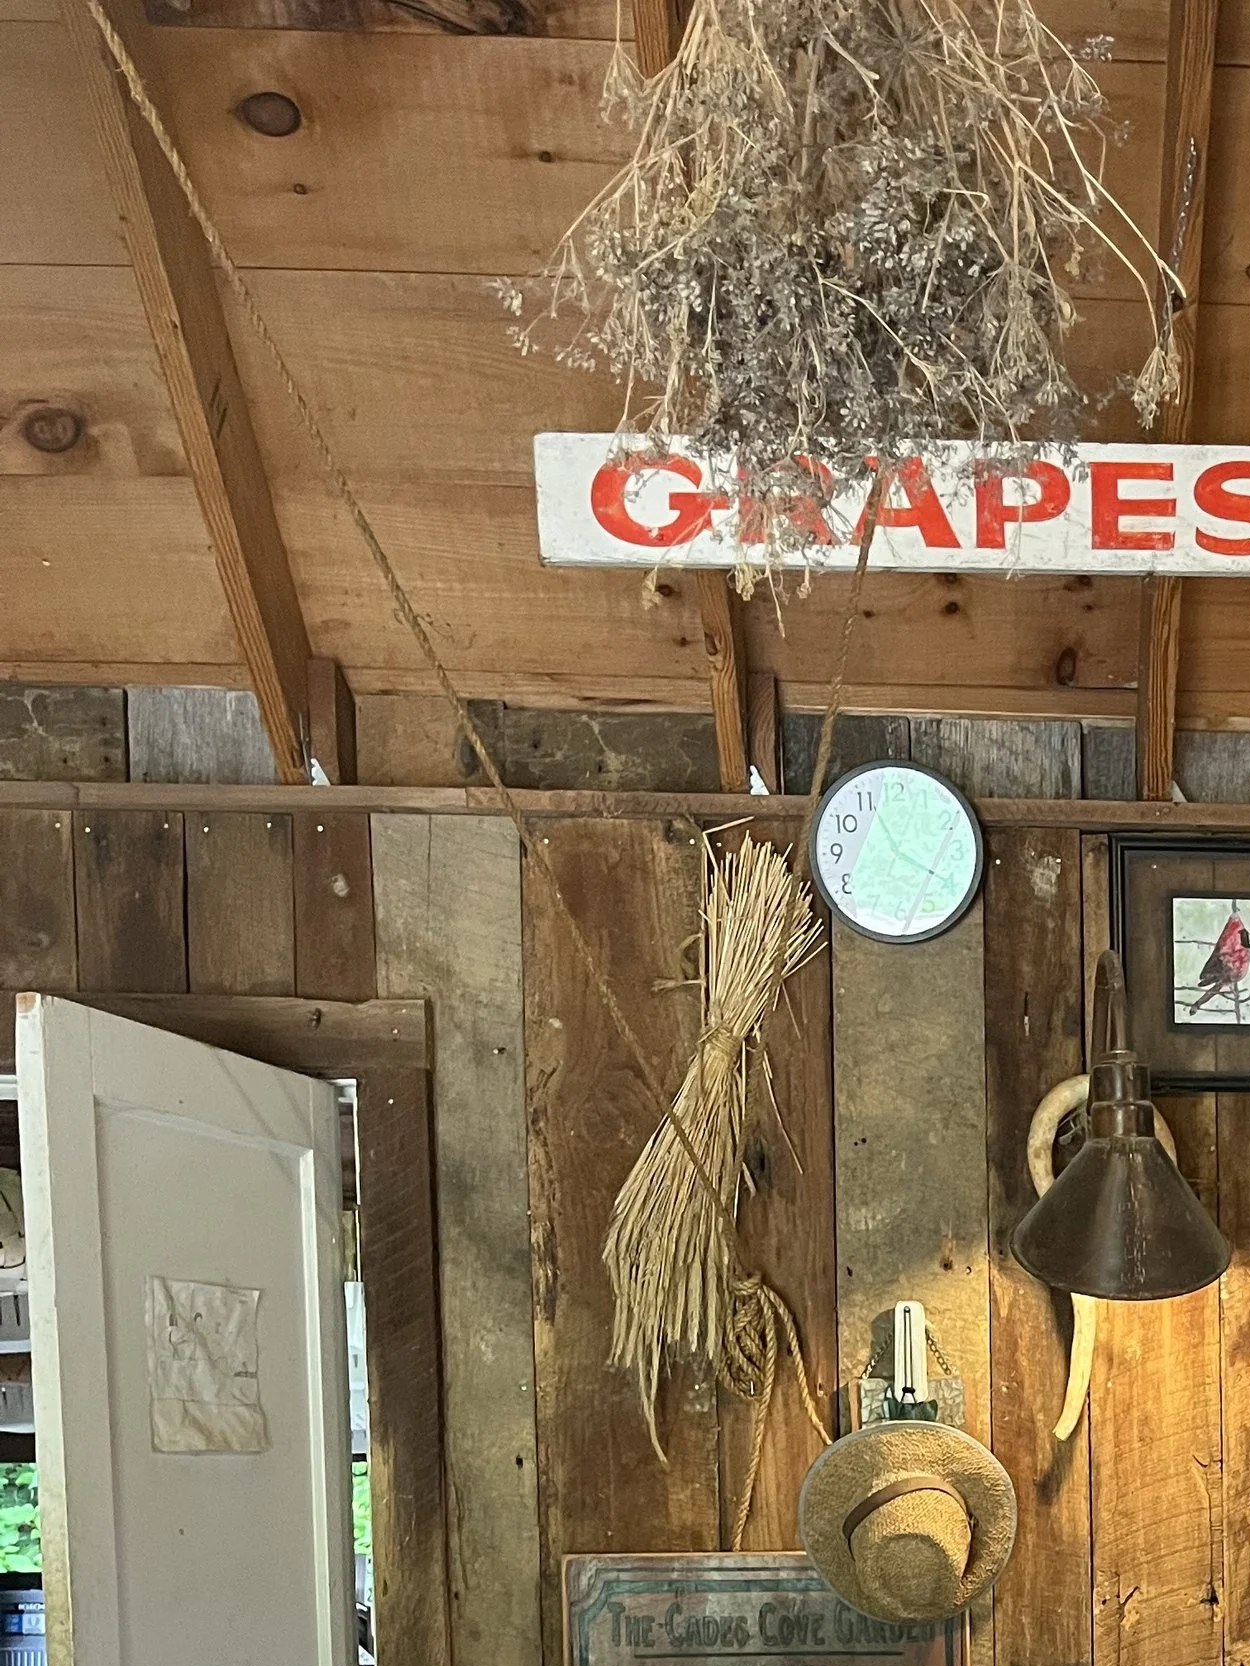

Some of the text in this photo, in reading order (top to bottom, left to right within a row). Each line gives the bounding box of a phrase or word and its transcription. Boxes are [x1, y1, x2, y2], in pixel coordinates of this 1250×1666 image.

[857, 792, 874, 811] 11
[884, 783, 905, 802] 12
[836, 814, 858, 833] 10
[939, 809, 953, 830] 2
[830, 843, 843, 864] 9
[951, 840, 964, 861] 3
[841, 873, 853, 894] 8
[607, 1602, 655, 1648] THE
[758, 1602, 826, 1647] COVE
